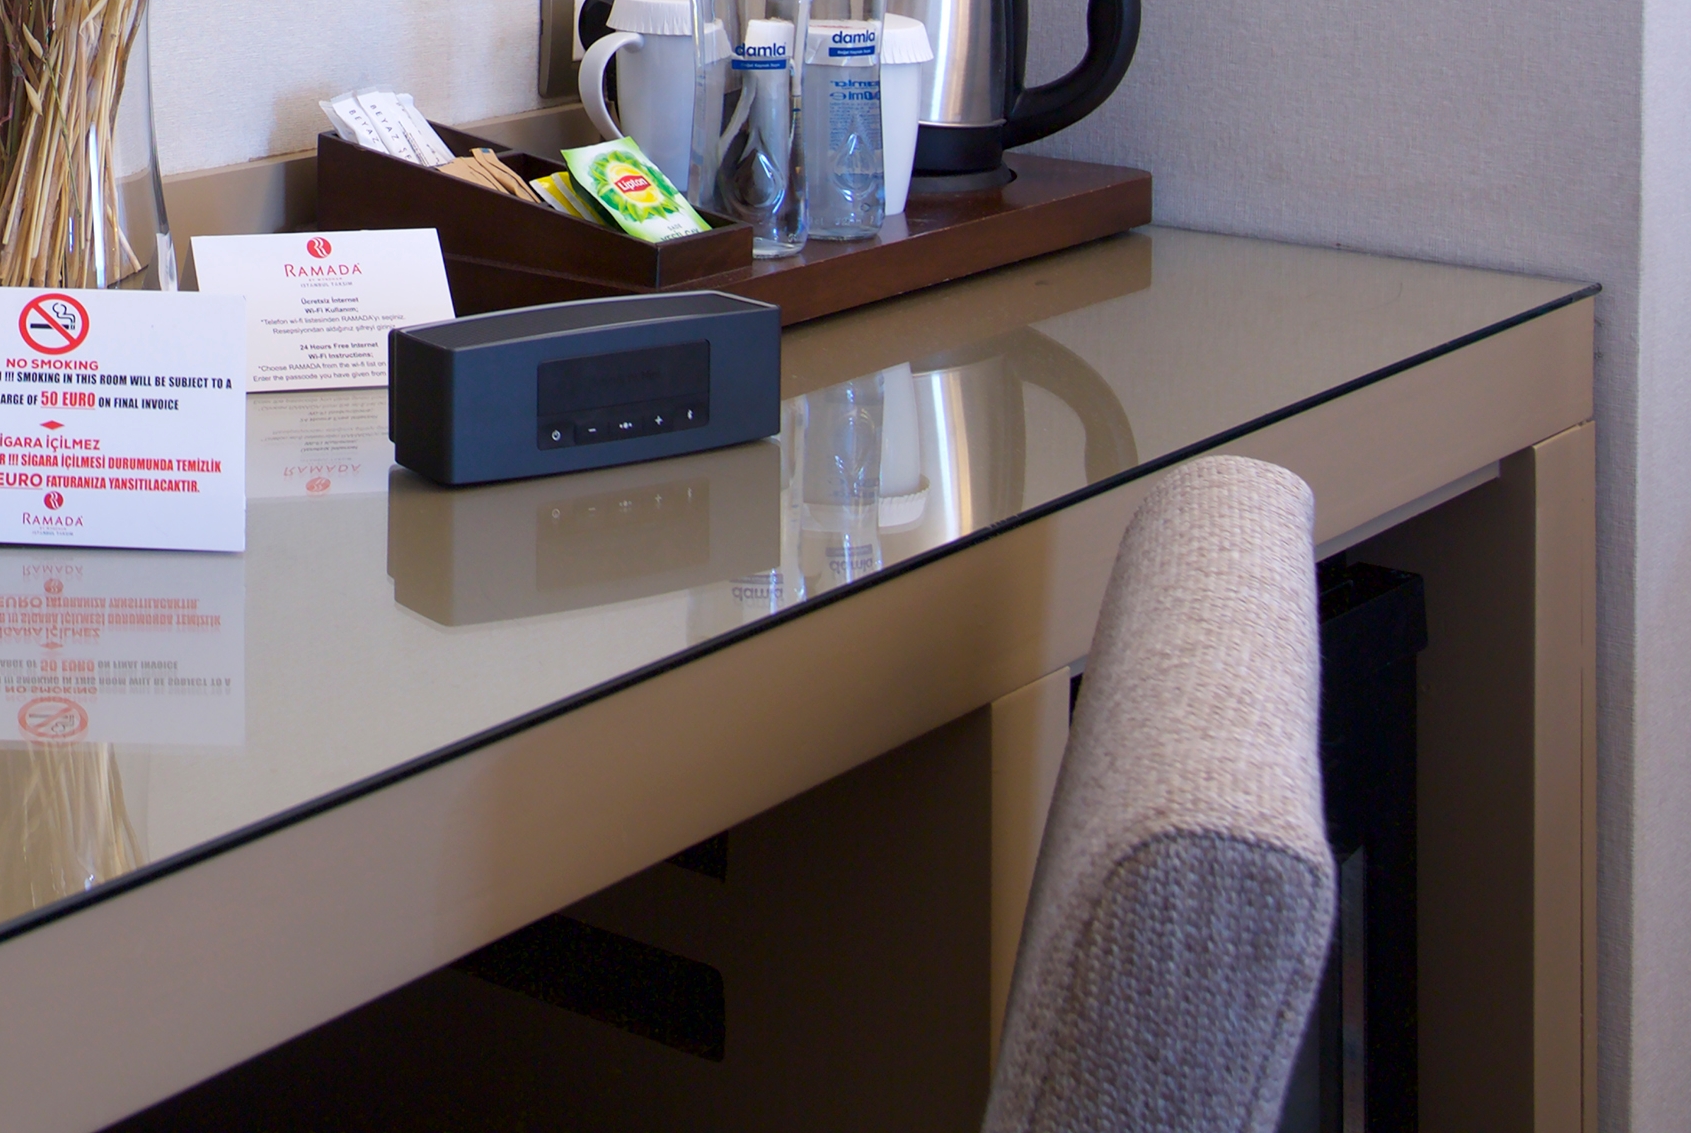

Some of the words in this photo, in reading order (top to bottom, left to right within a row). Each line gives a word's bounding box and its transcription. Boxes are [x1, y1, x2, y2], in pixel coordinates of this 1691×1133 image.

[832, 30, 876, 44] damla
[735, 42, 786, 57] damla
[349, 109, 379, 143] BEYAZ
[370, 104, 399, 140] BEYAZ
[618, 177, 647, 191] Lipton
[284, 263, 363, 277] RAMADA
[6, 358, 27, 368] NO
[32, 359, 99, 371] SMOKING
[17, 372, 60, 383] SMOKING
[63, 373, 72, 383] IN
[76, 374, 96, 385] THIS
[100, 375, 127, 386] ROOM
[130, 376, 152, 386] WILL
[154, 376, 166, 387] BE
[168, 377, 208, 388] SUBJECT
[212, 378, 223, 388] TO
[225, 378, 232, 389] A
[27, 395, 39, 405] OF
[41, 391, 58, 406] 50
[62, 392, 95, 407] EURO
[98, 397, 111, 408] ON
[114, 398, 138, 409] FINAL
[141, 399, 179, 410] INVOICE
[46, 435, 100, 453] İÇİLMEZ
[21, 452, 58, 466] SİGARA
[61, 454, 106, 470] İÇİLMESİ
[108, 457, 174, 471] DURUMUNDA
[177, 458, 221, 473] TEMİZLİK
[46, 475, 106, 489] FATURANIZA
[109, 477, 200, 493] YANSITILACAKTIR.
[22, 512, 83, 526] RAMADA
